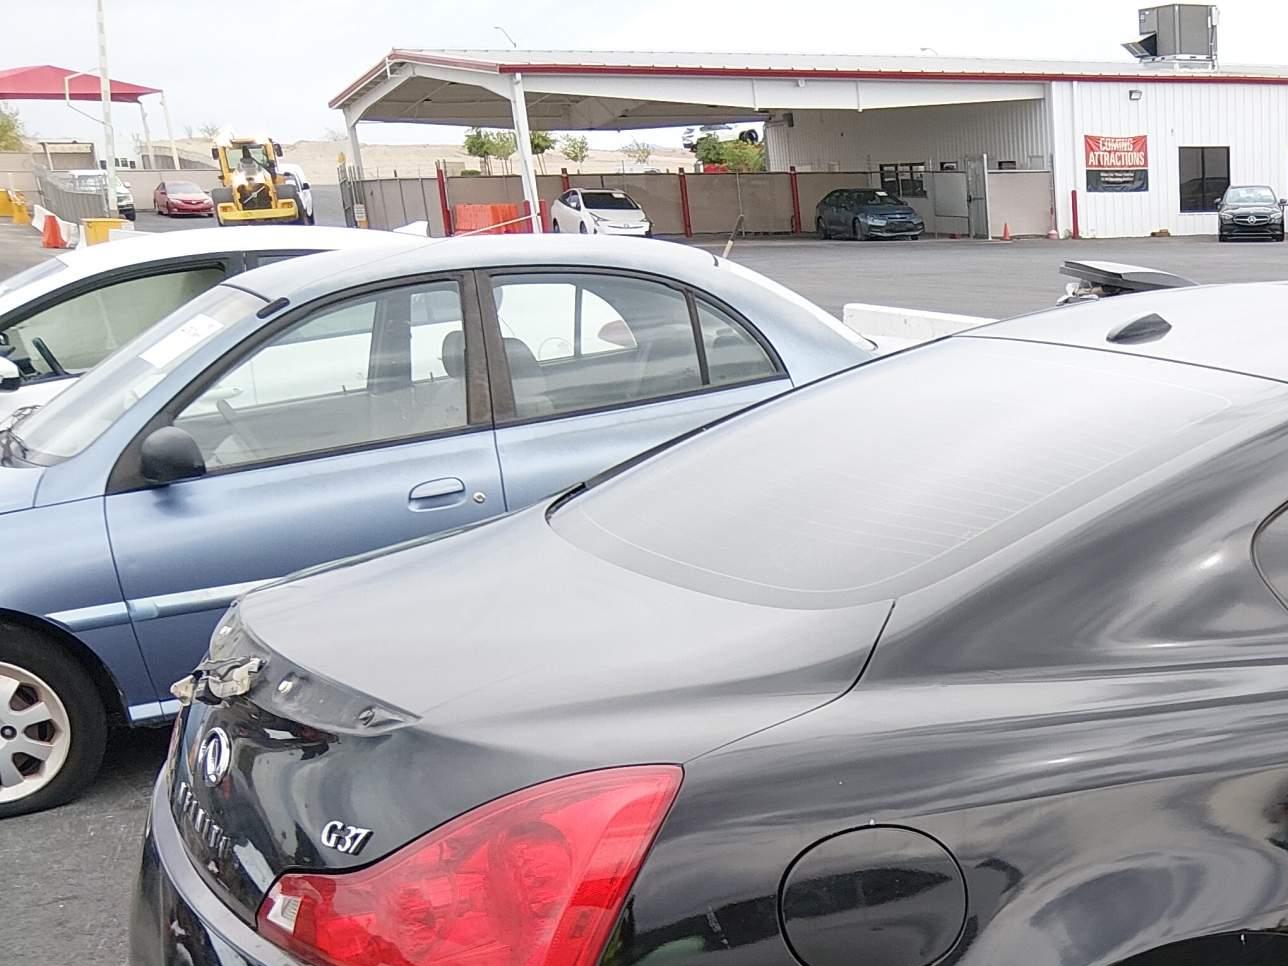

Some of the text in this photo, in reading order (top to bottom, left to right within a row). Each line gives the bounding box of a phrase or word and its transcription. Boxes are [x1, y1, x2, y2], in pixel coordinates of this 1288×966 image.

[1099, 137, 1133, 152] COMING
[1088, 151, 1145, 166] ATTRACTIONS
[320, 820, 374, 856] G37
